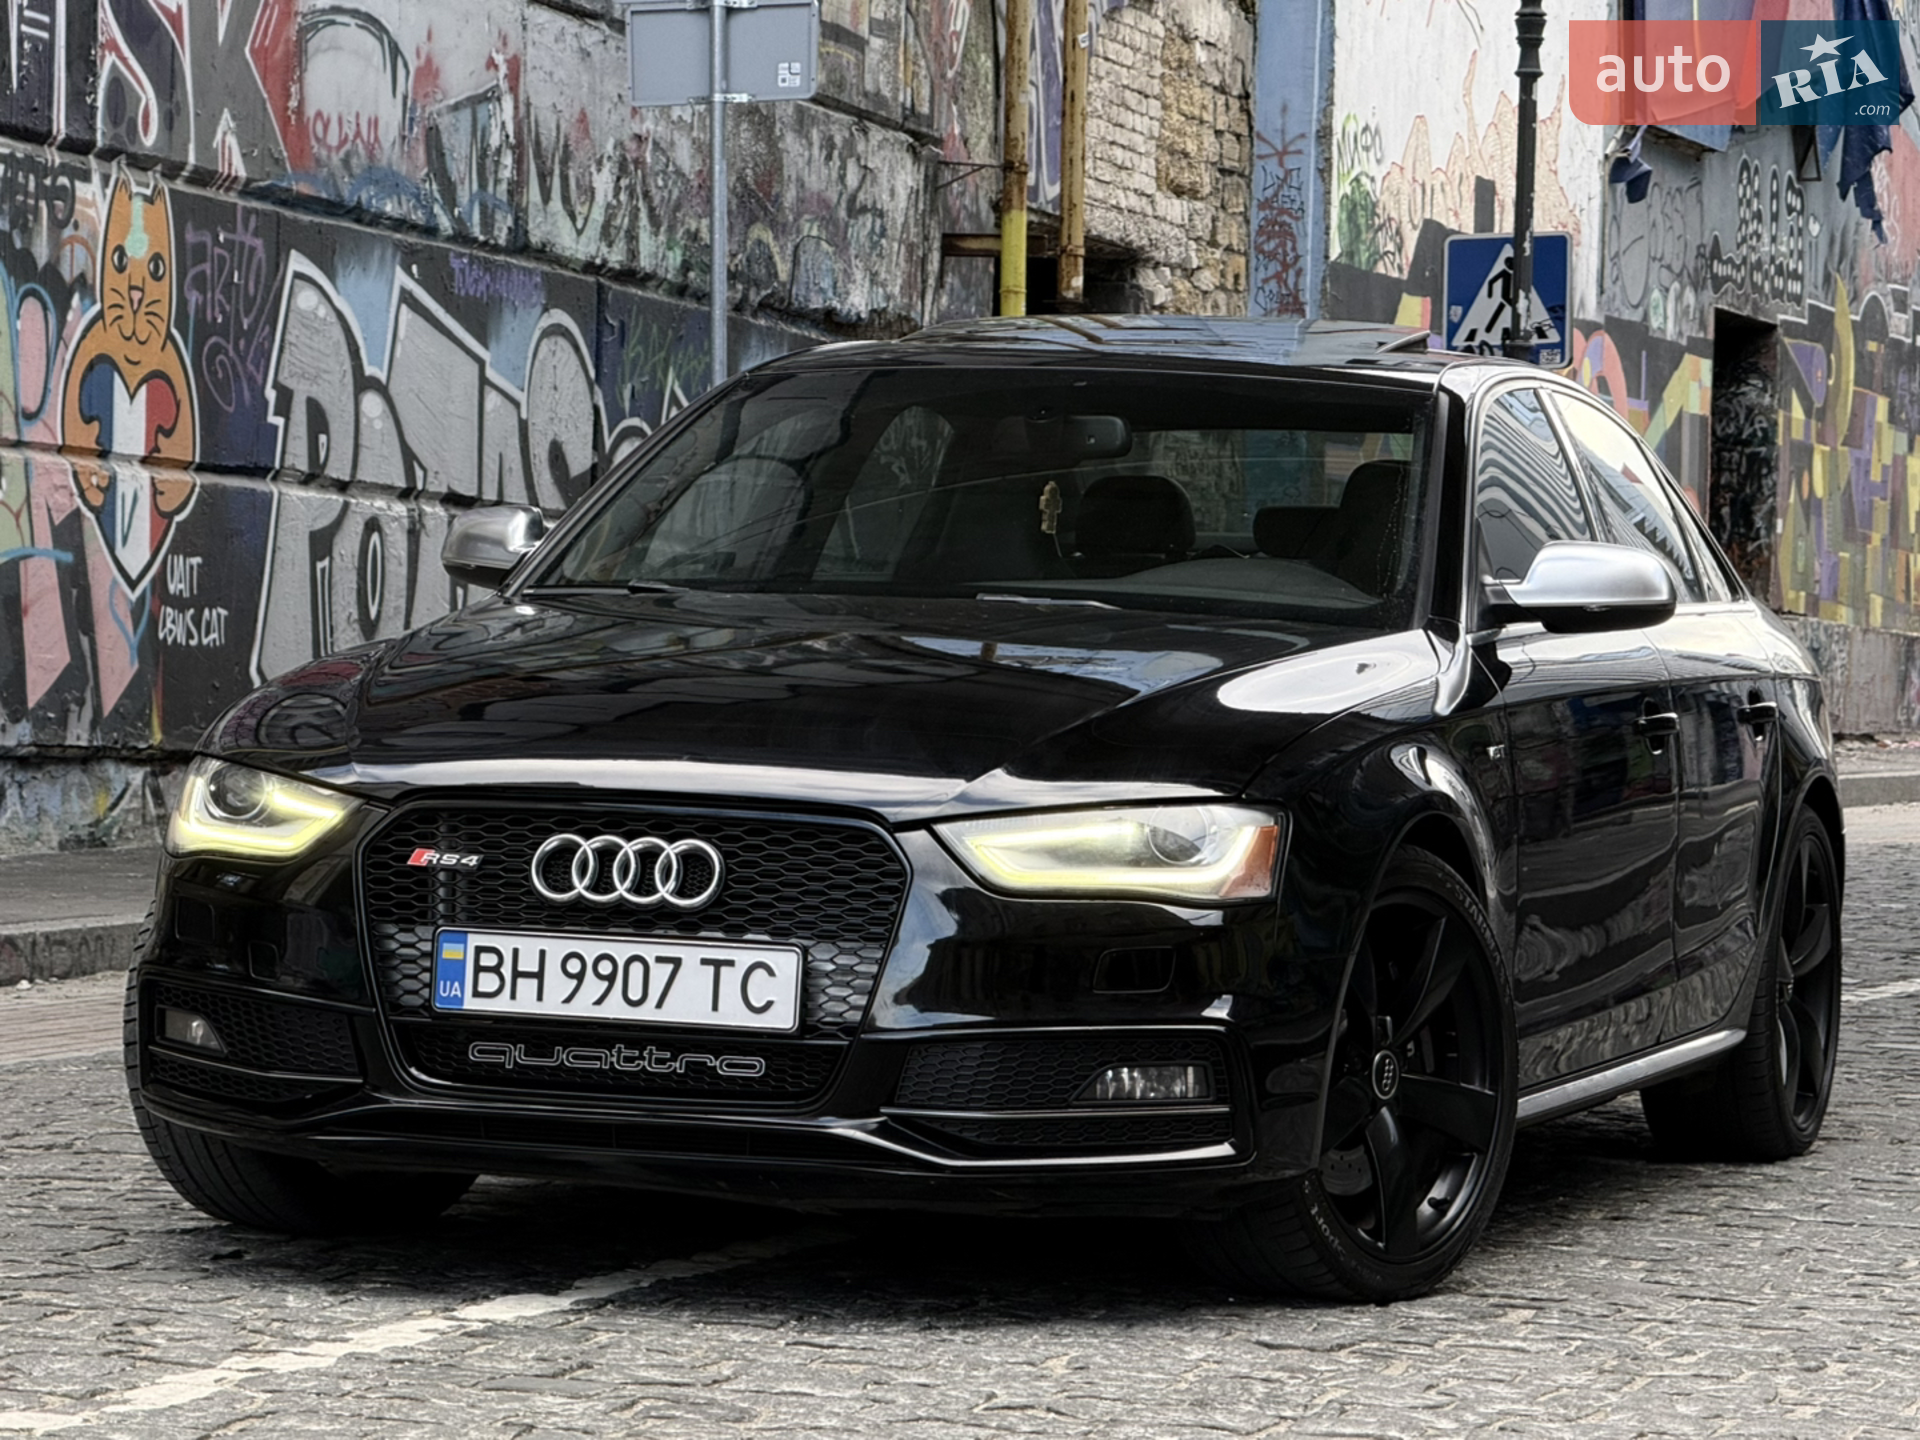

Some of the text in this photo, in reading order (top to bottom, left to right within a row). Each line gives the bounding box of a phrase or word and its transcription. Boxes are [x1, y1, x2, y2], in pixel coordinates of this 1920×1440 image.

[201, 606, 229, 648] CAT
[419, 852, 480, 867] RS4
[439, 980, 462, 998] UA
[471, 944, 778, 1015] BH 9907 TC
[468, 1040, 766, 1077] quattro
